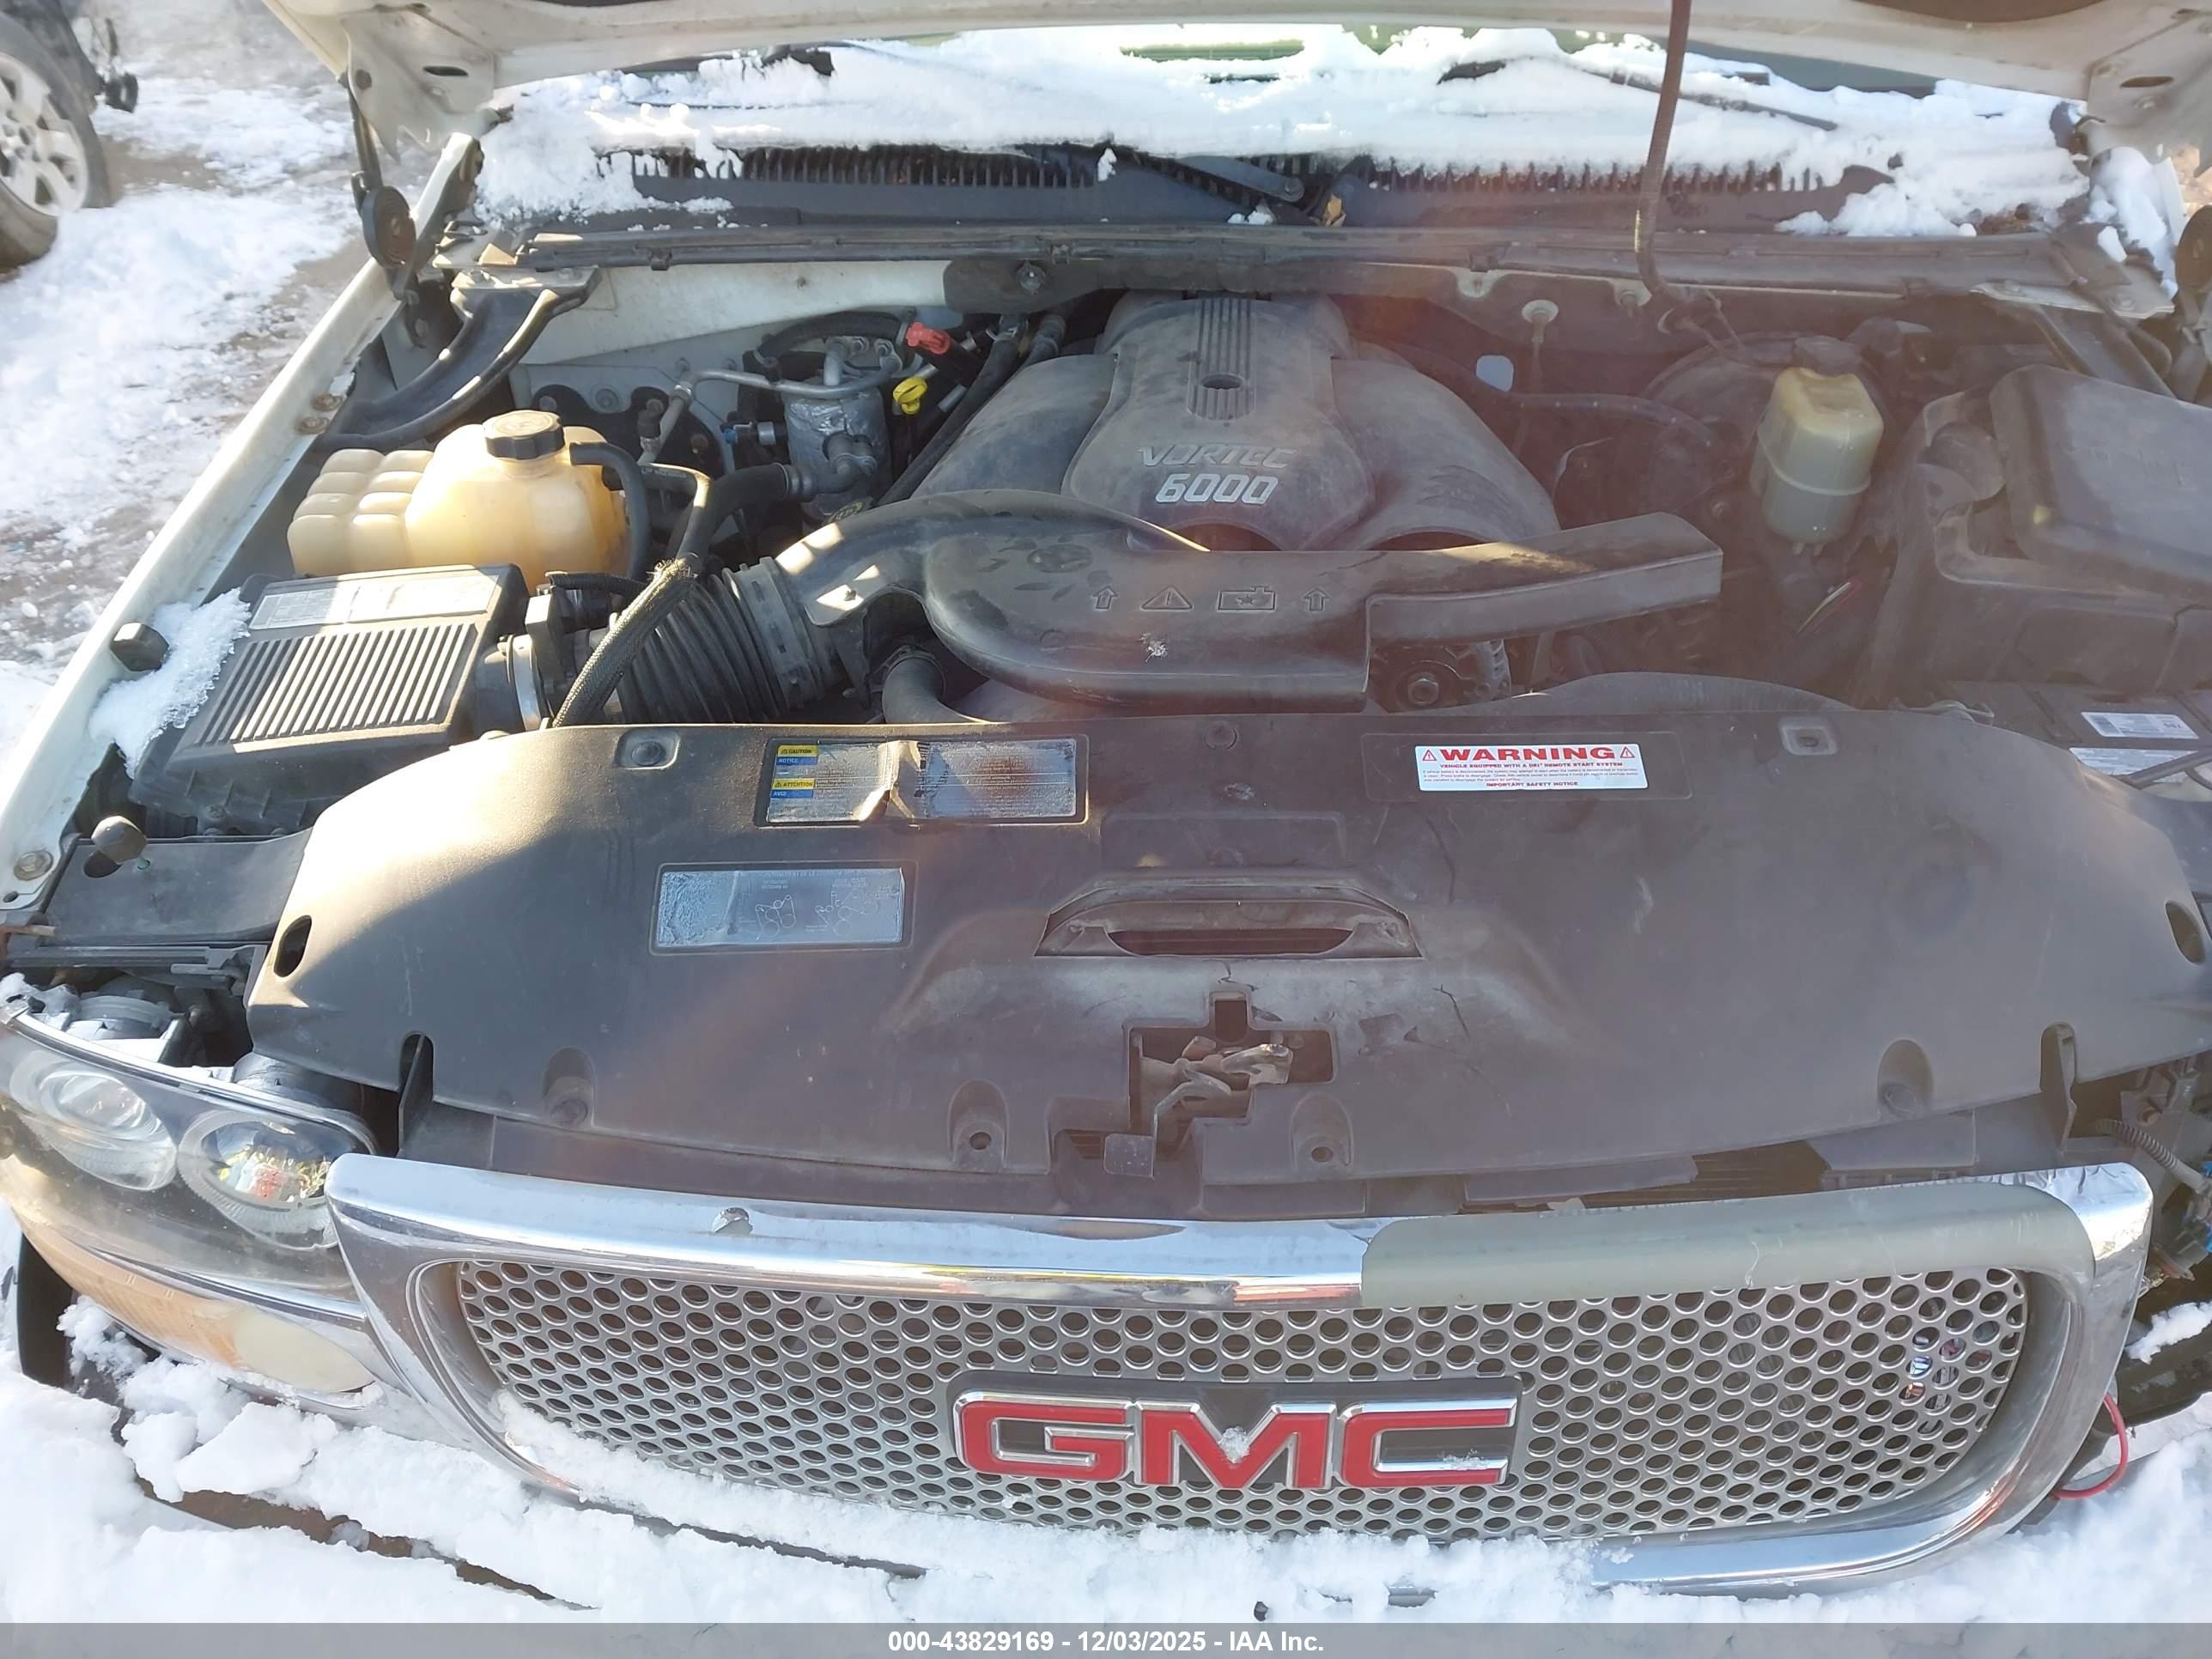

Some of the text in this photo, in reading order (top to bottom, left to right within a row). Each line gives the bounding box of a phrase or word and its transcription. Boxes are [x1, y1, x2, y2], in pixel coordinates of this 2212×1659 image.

[1138, 443, 1297, 468] VORTEC
[1155, 473, 1279, 504] 6000
[1439, 746, 1615, 761] WARNING
[954, 1390, 1517, 1490] GMC
